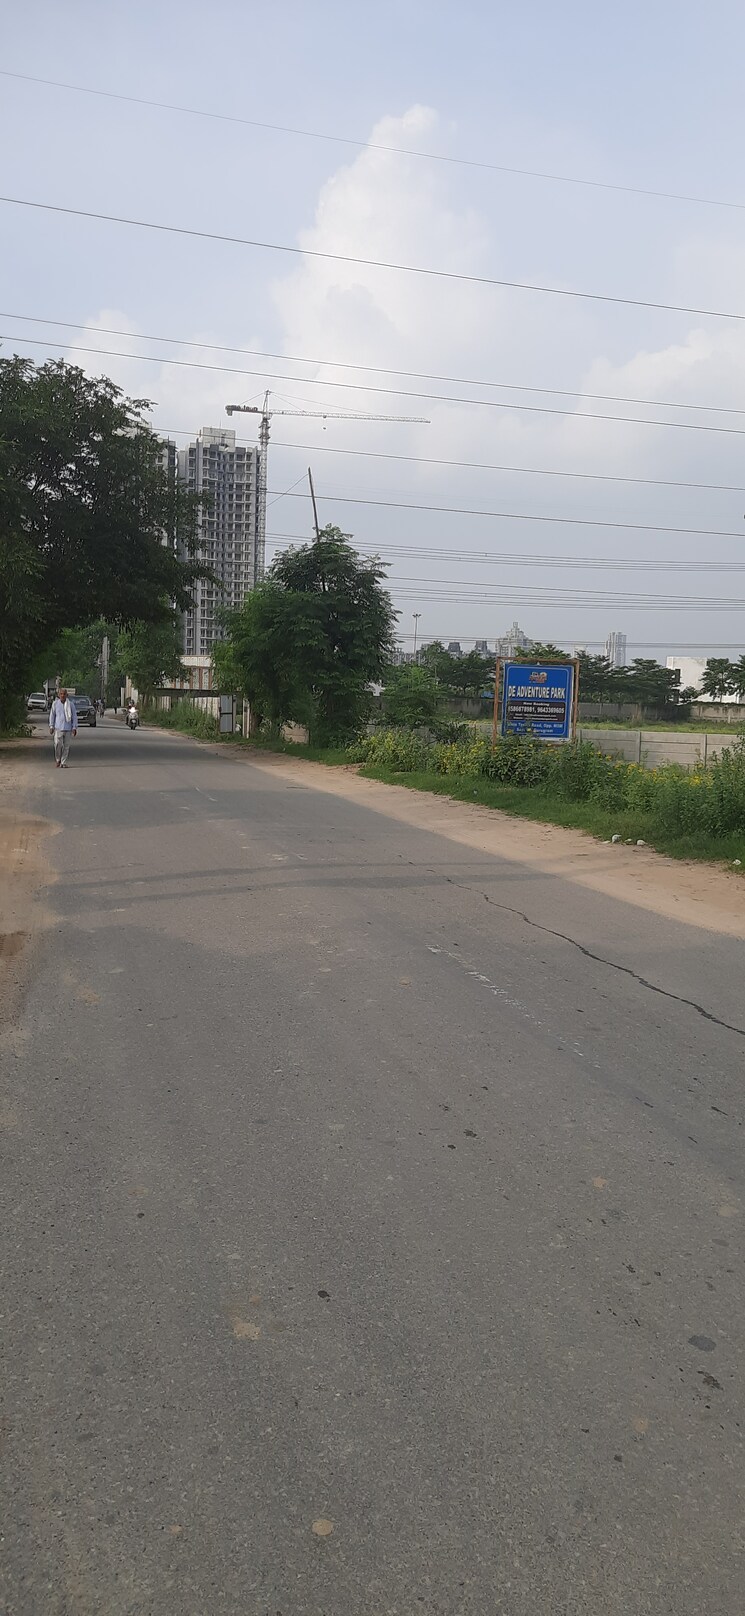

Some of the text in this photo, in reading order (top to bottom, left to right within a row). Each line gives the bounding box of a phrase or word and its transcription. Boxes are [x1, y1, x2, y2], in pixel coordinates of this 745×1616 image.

[508, 686, 566, 699] DE ADVENTURE PARK
